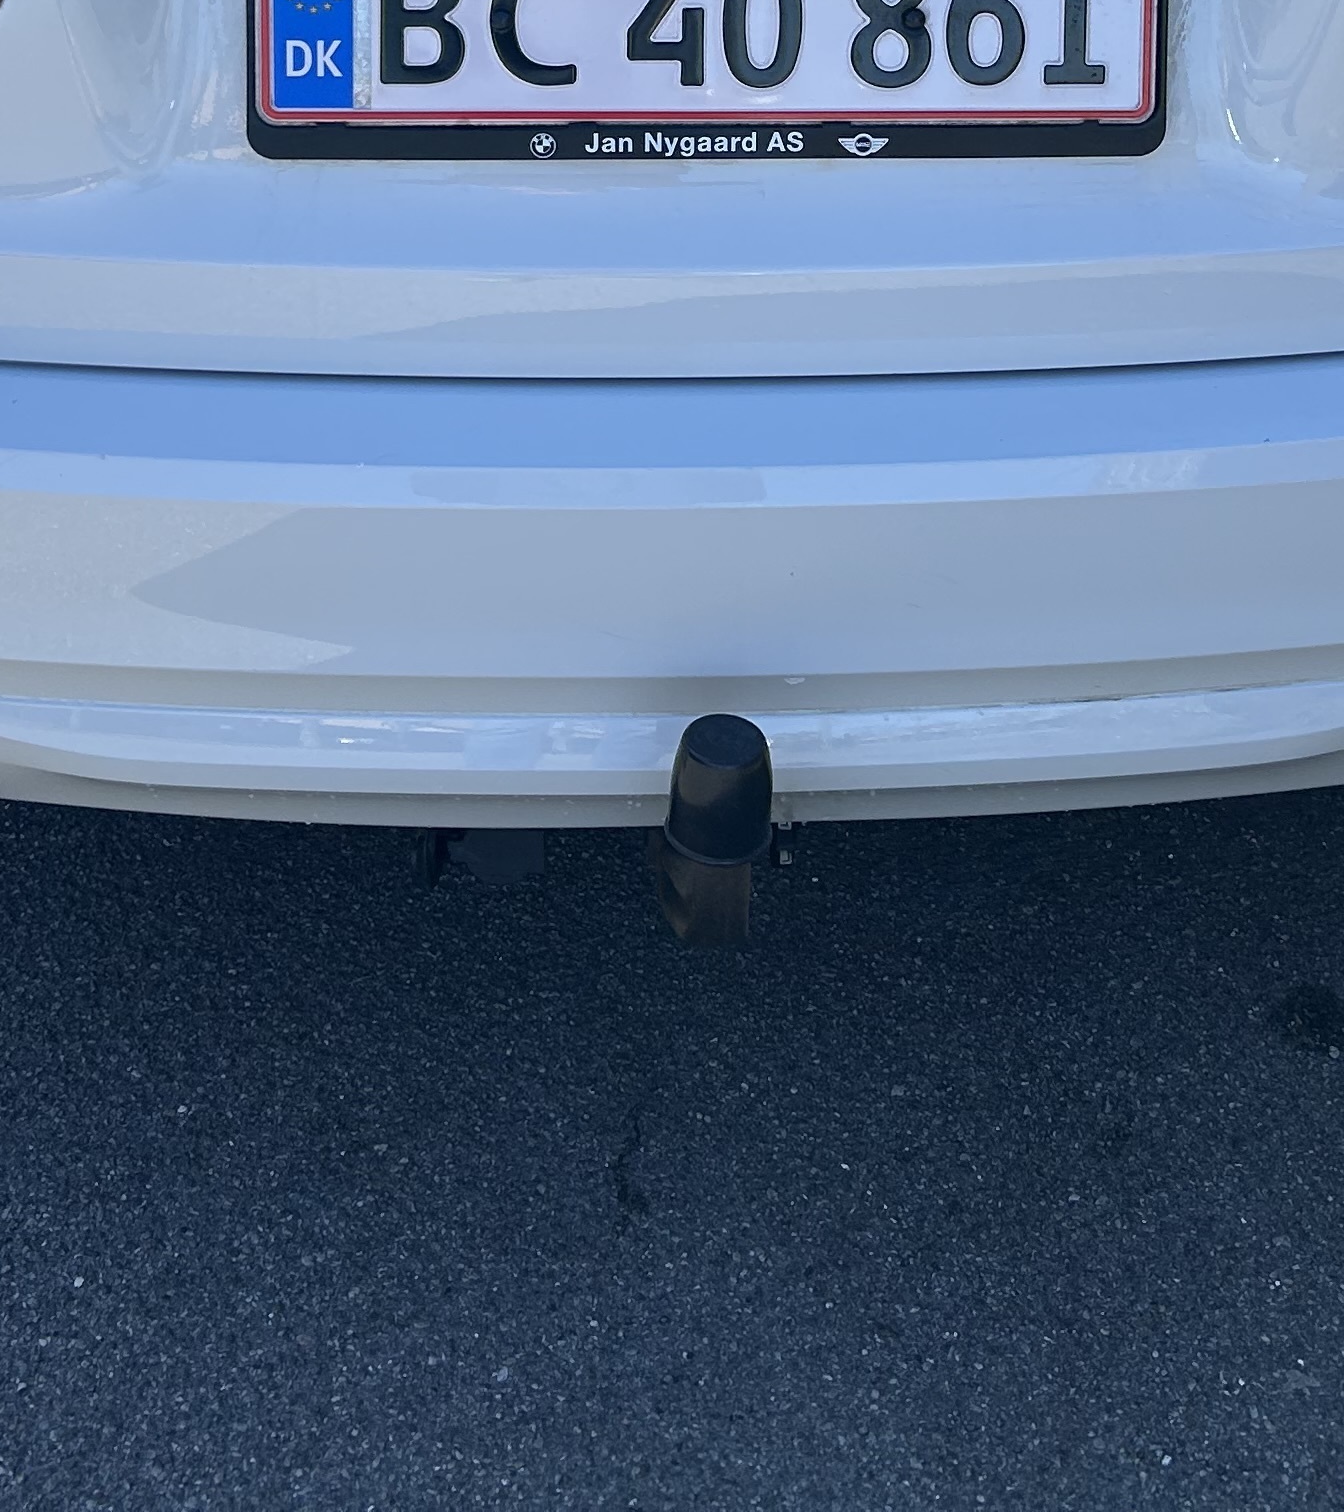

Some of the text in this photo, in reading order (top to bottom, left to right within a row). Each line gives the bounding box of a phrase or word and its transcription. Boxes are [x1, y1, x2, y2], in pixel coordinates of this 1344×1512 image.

[286, 39, 344, 77] DK
[584, 131, 805, 157] Jan Nygaard AS
